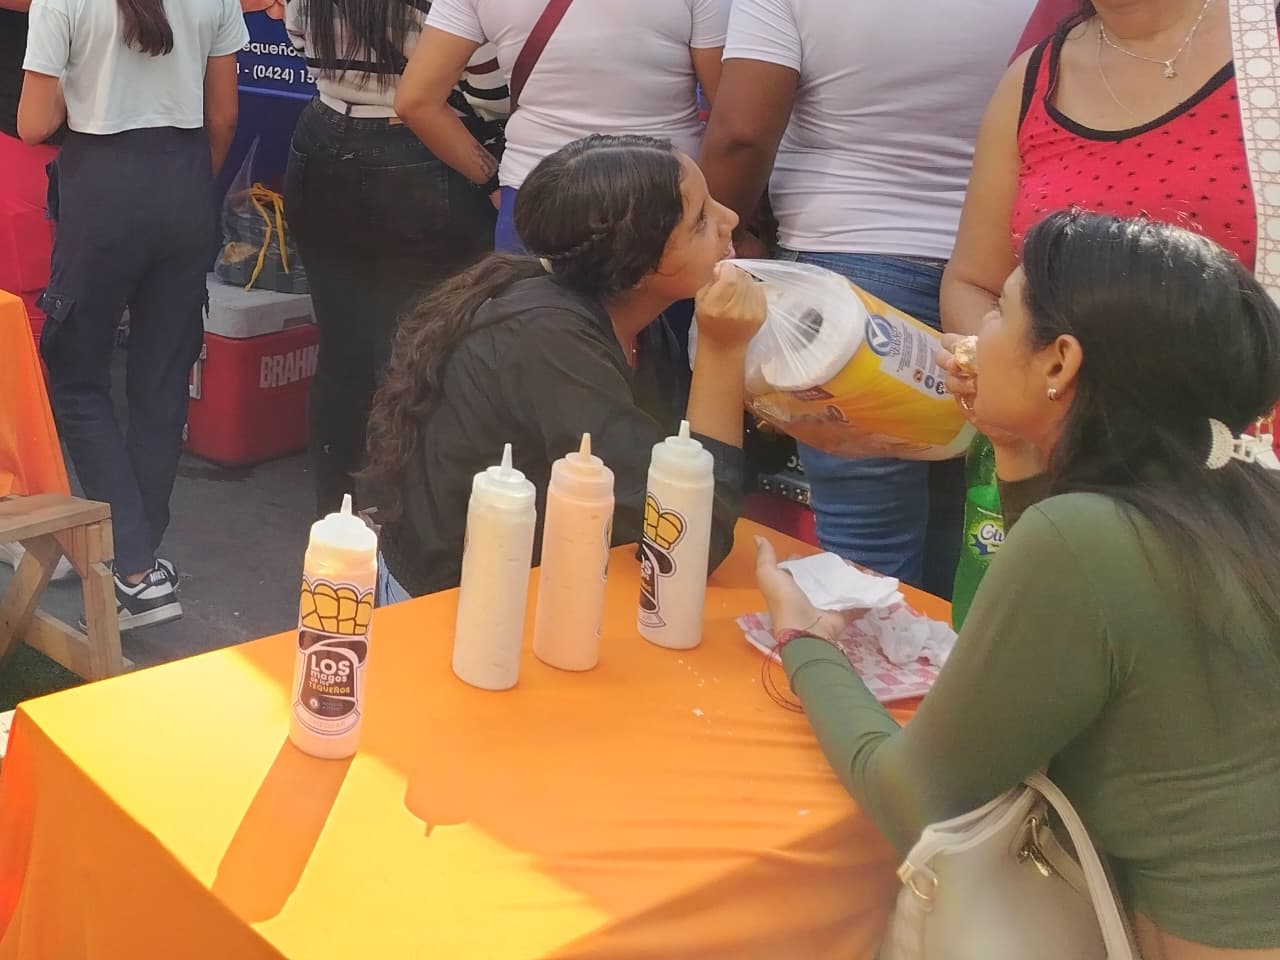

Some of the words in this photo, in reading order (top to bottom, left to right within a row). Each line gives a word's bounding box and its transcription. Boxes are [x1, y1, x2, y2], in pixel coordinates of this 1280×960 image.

[149, 570, 166, 583] NIKE
[311, 654, 351, 676] LOS
[311, 670, 348, 685] magos
